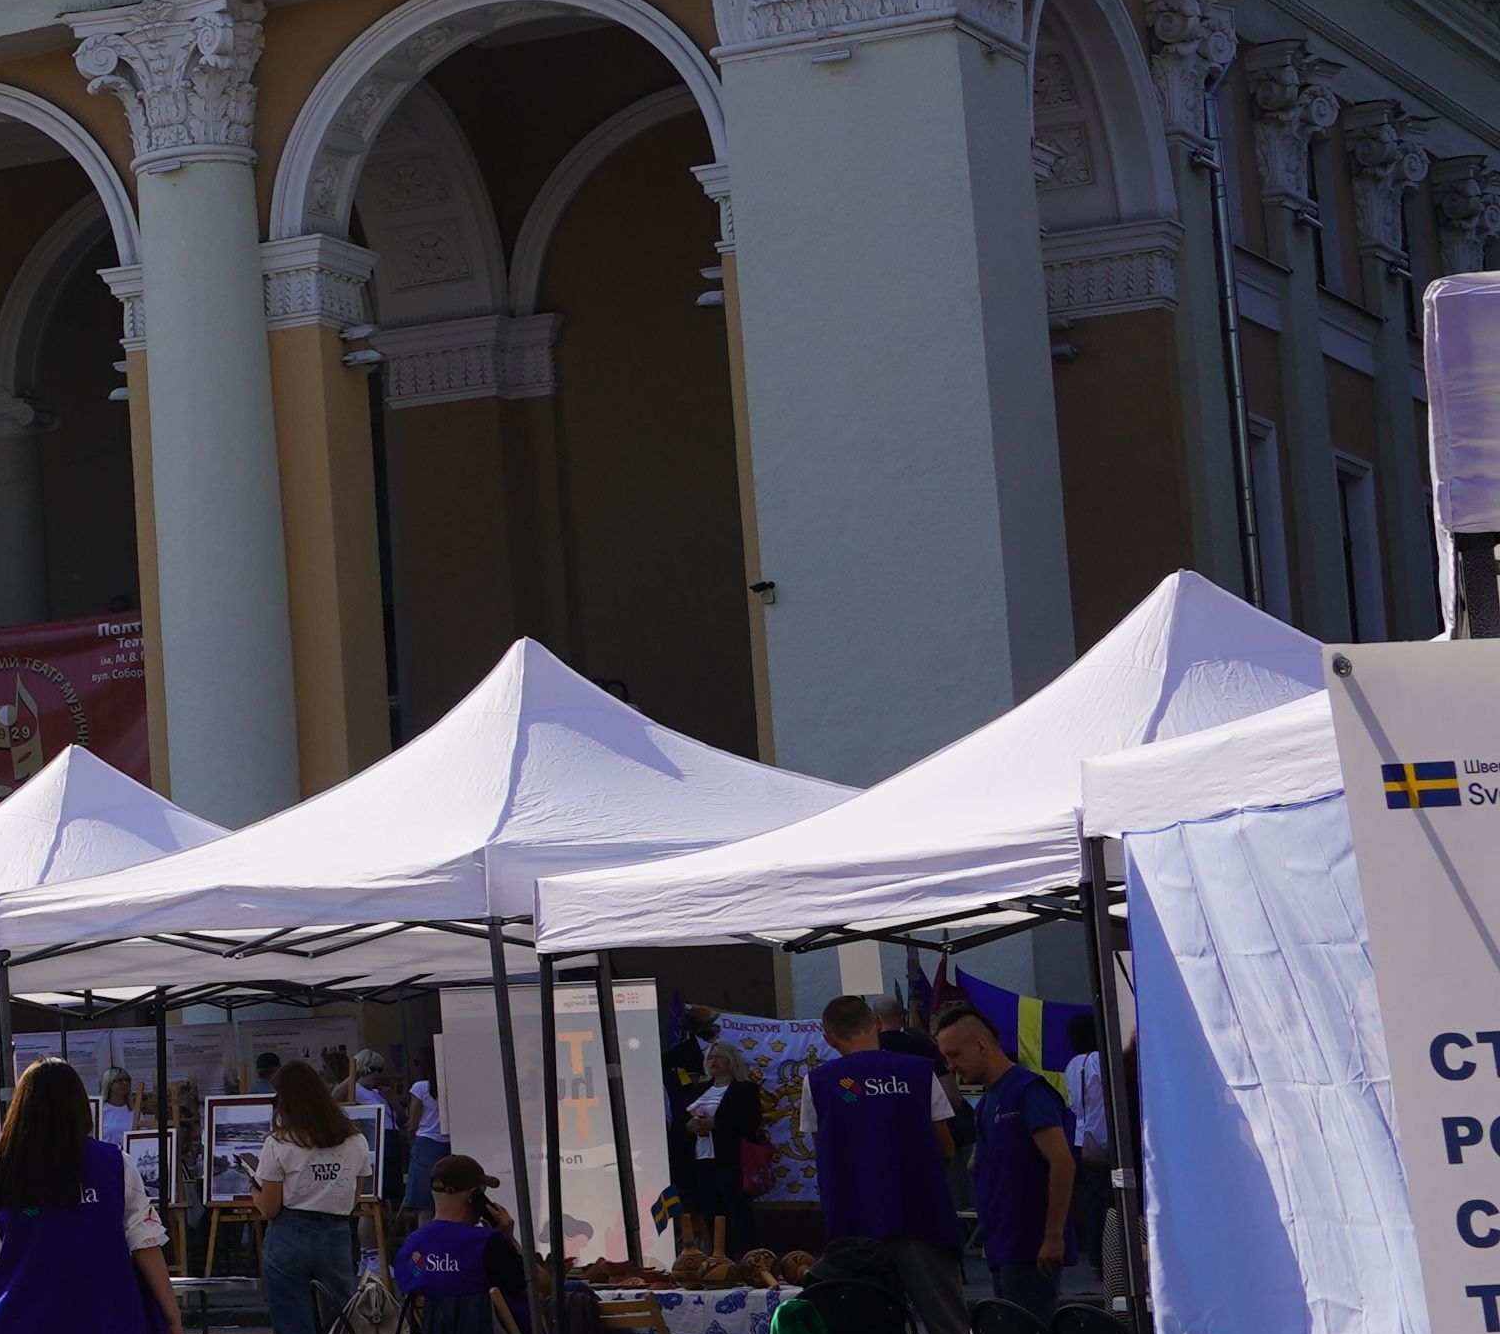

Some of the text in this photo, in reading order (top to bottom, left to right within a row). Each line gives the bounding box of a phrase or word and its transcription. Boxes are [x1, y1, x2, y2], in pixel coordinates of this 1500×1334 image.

[1463, 759, 1500, 774] Шве
[1468, 782, 1500, 806] Sv
[864, 1075, 911, 1096] Sida
[1441, 1115, 1500, 1165] Р
[314, 1170, 338, 1181] hub
[425, 1252, 461, 1272] Sida
